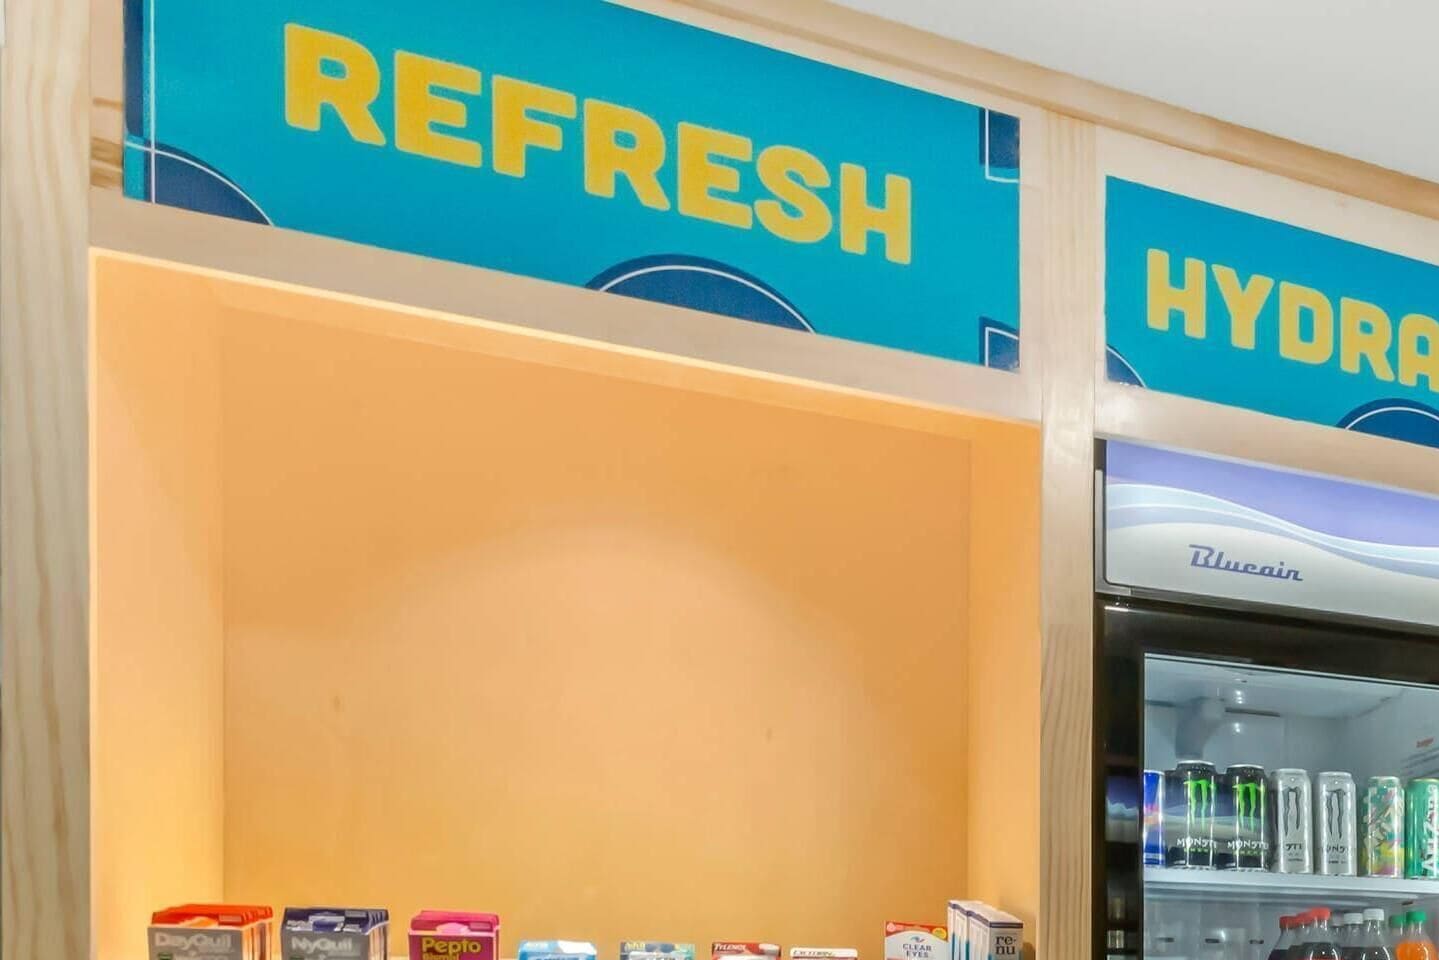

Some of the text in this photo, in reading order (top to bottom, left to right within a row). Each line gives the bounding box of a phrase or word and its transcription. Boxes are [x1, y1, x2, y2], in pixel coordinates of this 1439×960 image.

[283, 21, 913, 266] REFRESH
[154, 931, 232, 952] DayQuil
[291, 936, 353, 952] NyQuil
[421, 936, 482, 957] Pepto
[902, 943, 932, 951] CLEAR
[906, 950, 929, 959] EYES
